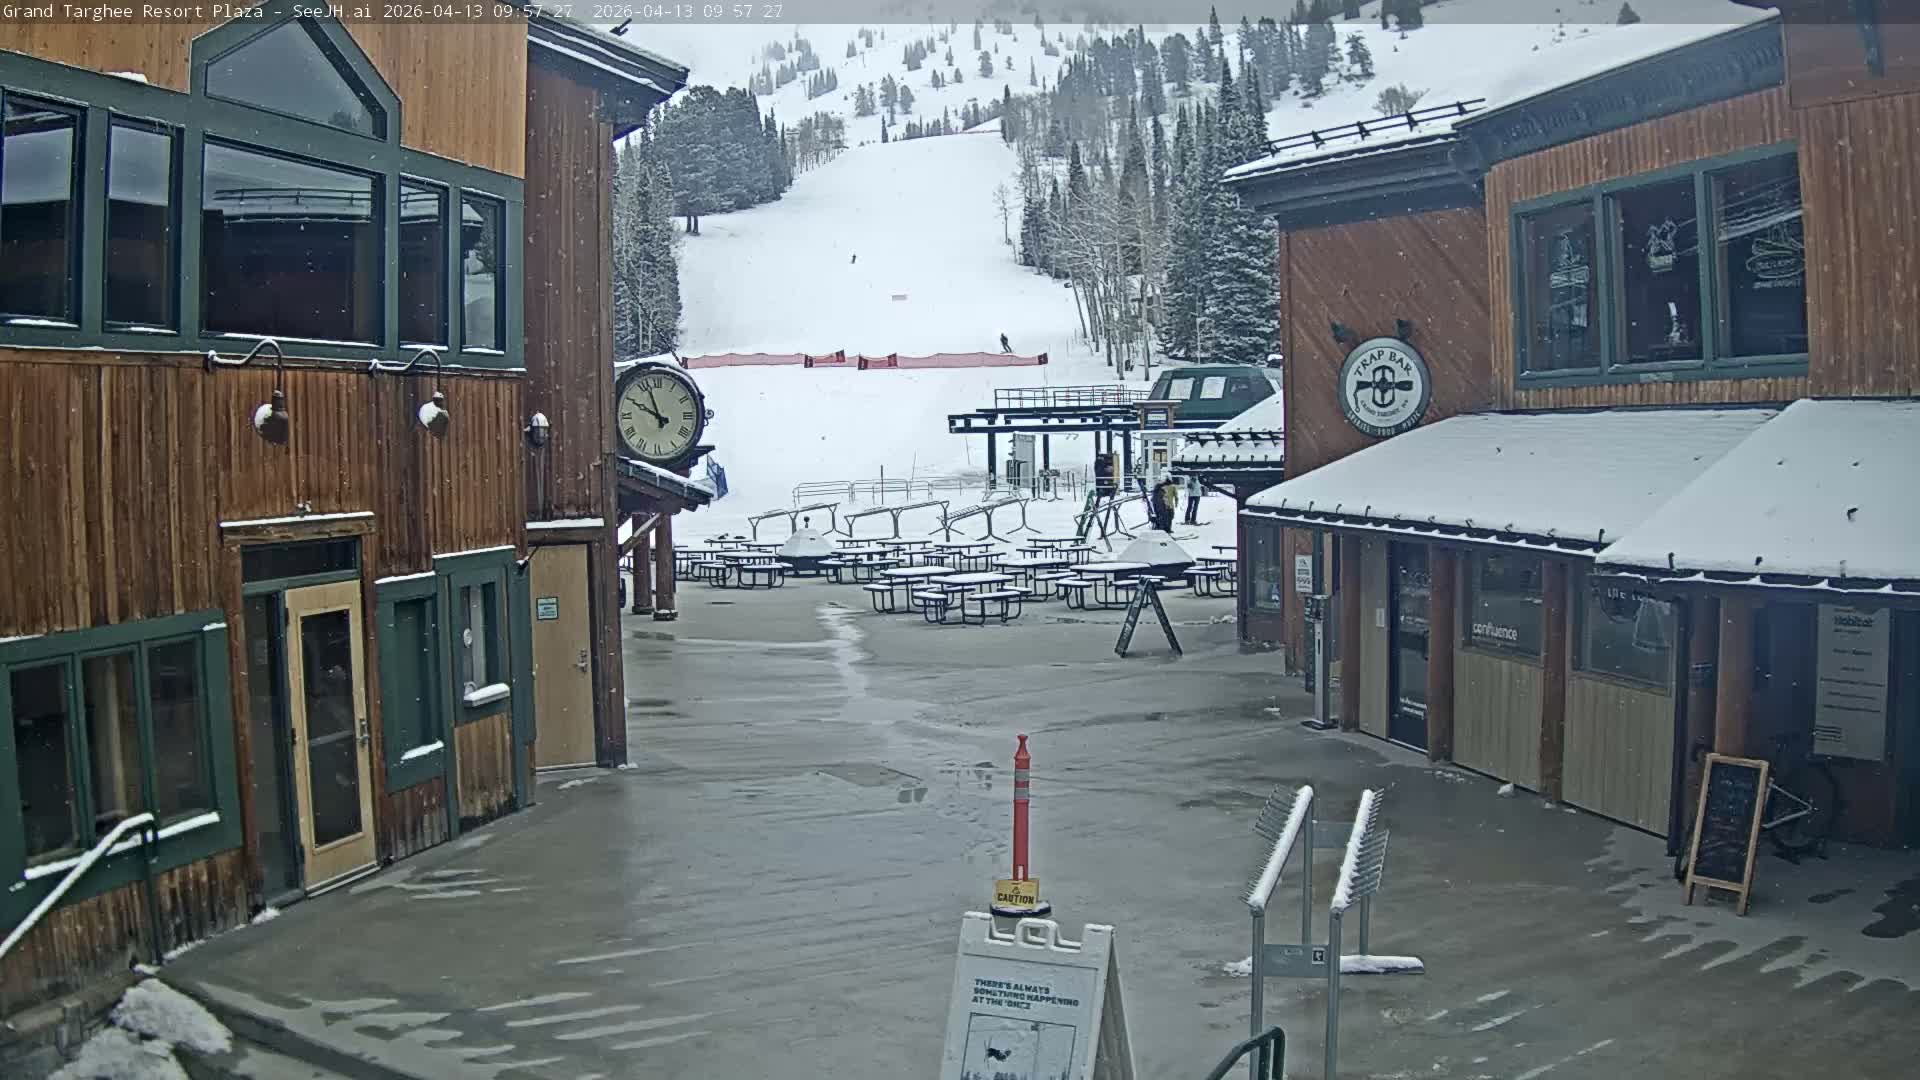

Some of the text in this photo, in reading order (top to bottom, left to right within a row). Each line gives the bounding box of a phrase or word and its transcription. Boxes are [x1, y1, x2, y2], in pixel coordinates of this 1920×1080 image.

[1354, 349, 1413, 377] TRAP BAR
[683, 412, 693, 420] III
[1473, 621, 1518, 640] confluence
[997, 893, 1035, 904] CAUTION
[974, 978, 1050, 995] THERE'S ALWAYS
[972, 996, 985, 1004] AT
[986, 997, 1003, 1006] THE
[974, 987, 1080, 1007] SOMETHING HAPPENING
